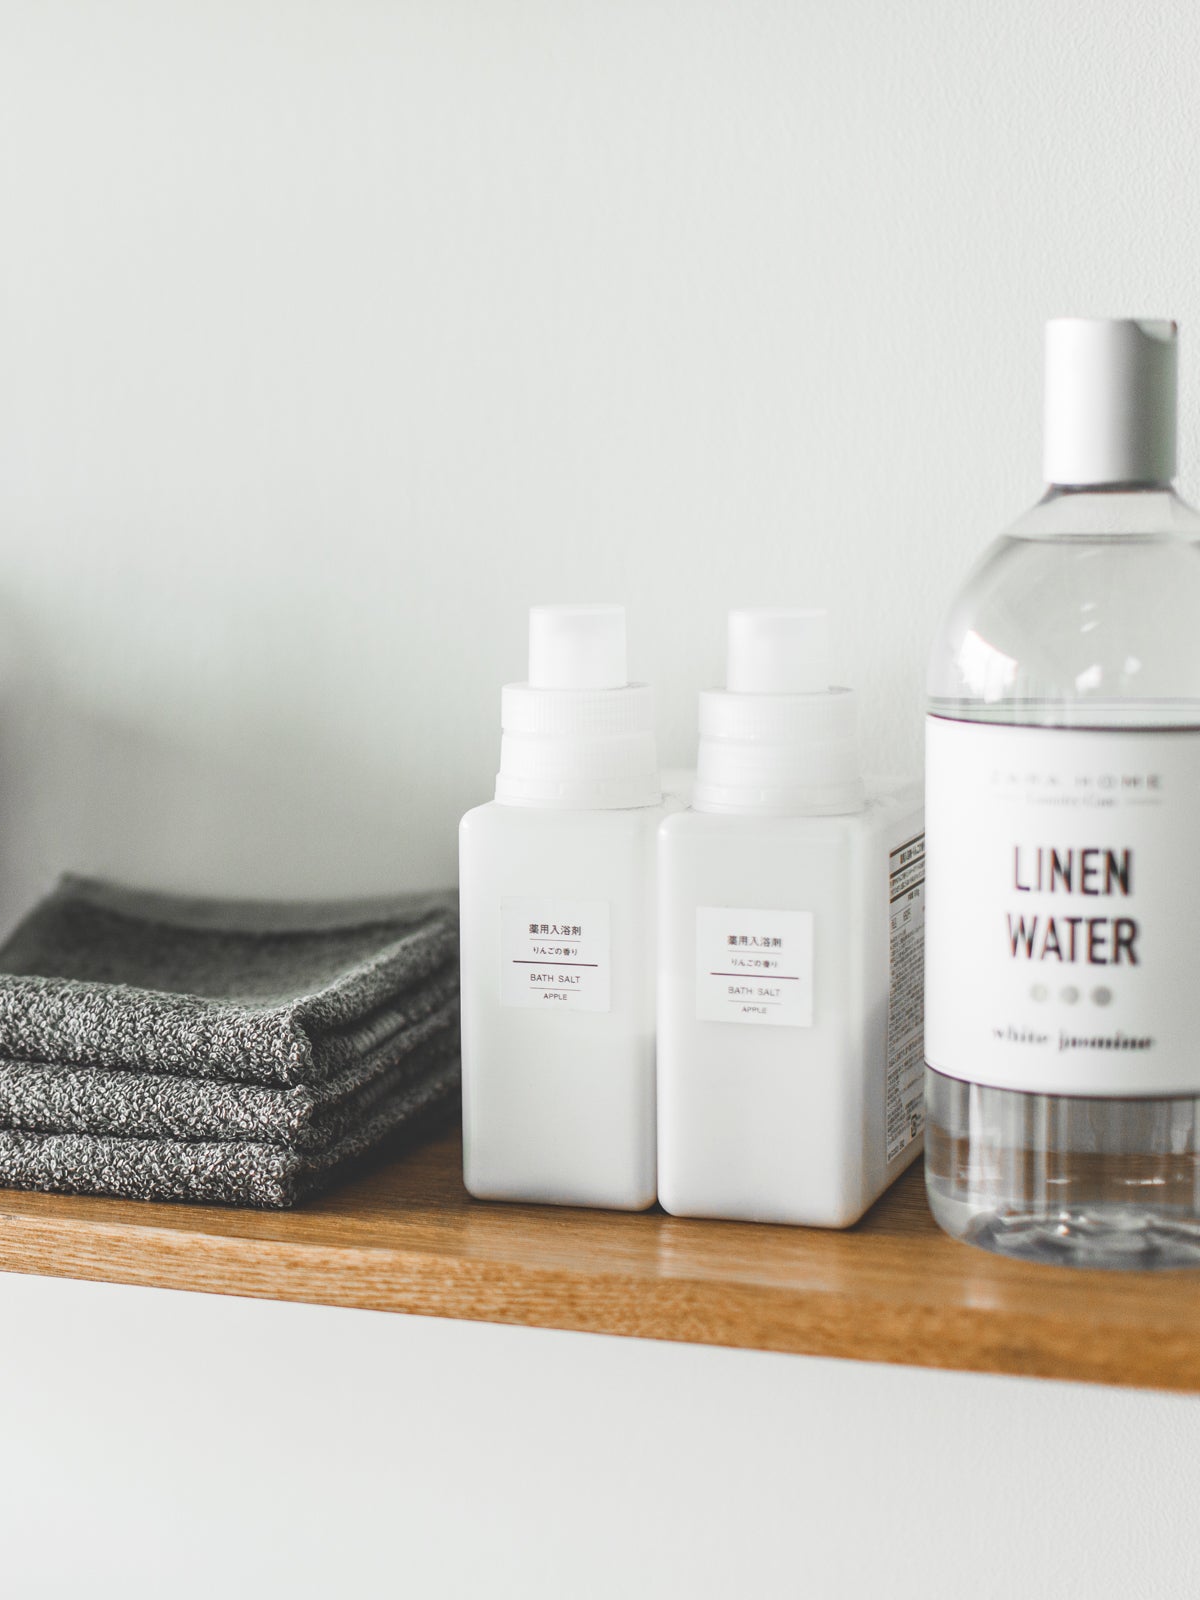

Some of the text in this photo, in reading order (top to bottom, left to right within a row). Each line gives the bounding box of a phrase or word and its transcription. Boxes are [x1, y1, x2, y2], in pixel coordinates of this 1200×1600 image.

[1013, 846, 1133, 896] LINEN
[529, 923, 581, 936] 薬用入浴剤
[1006, 913, 1140, 967] WATER
[533, 946, 577, 956] りんごの香り
[530, 973, 581, 984] BATH SALT
[543, 993, 568, 1001] APPLE
[728, 986, 781, 997] BATH SALT
[741, 1006, 767, 1014] APPLE
